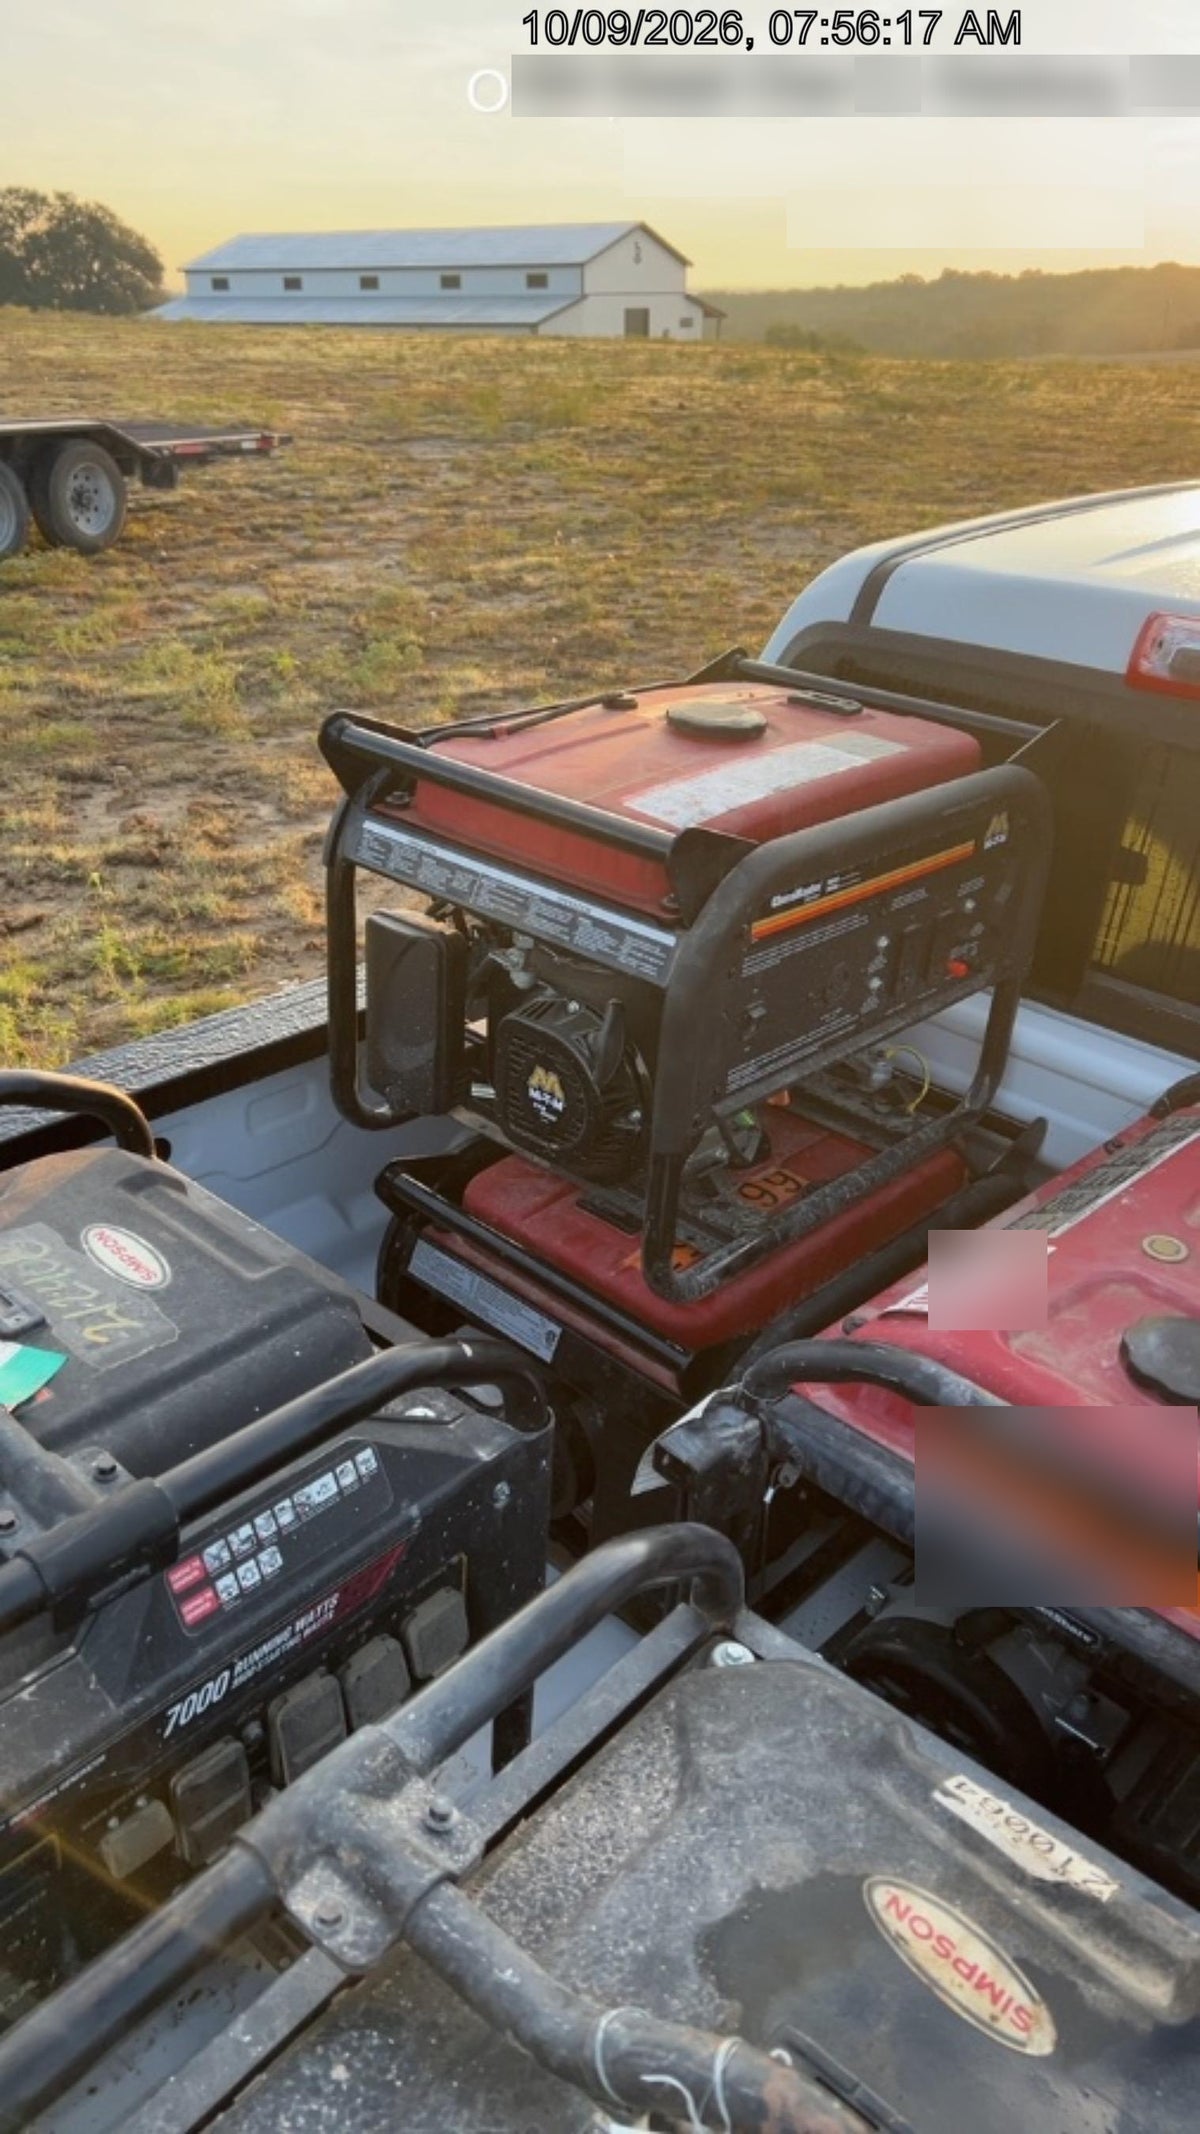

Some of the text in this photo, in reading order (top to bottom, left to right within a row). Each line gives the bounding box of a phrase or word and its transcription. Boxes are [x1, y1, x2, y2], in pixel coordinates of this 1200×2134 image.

[94, 1229, 158, 1282] SIMPSON
[164, 1668, 229, 1738] 7000
[295, 1592, 338, 1632] WATTS
[885, 1893, 1034, 2034] SIMPSON
